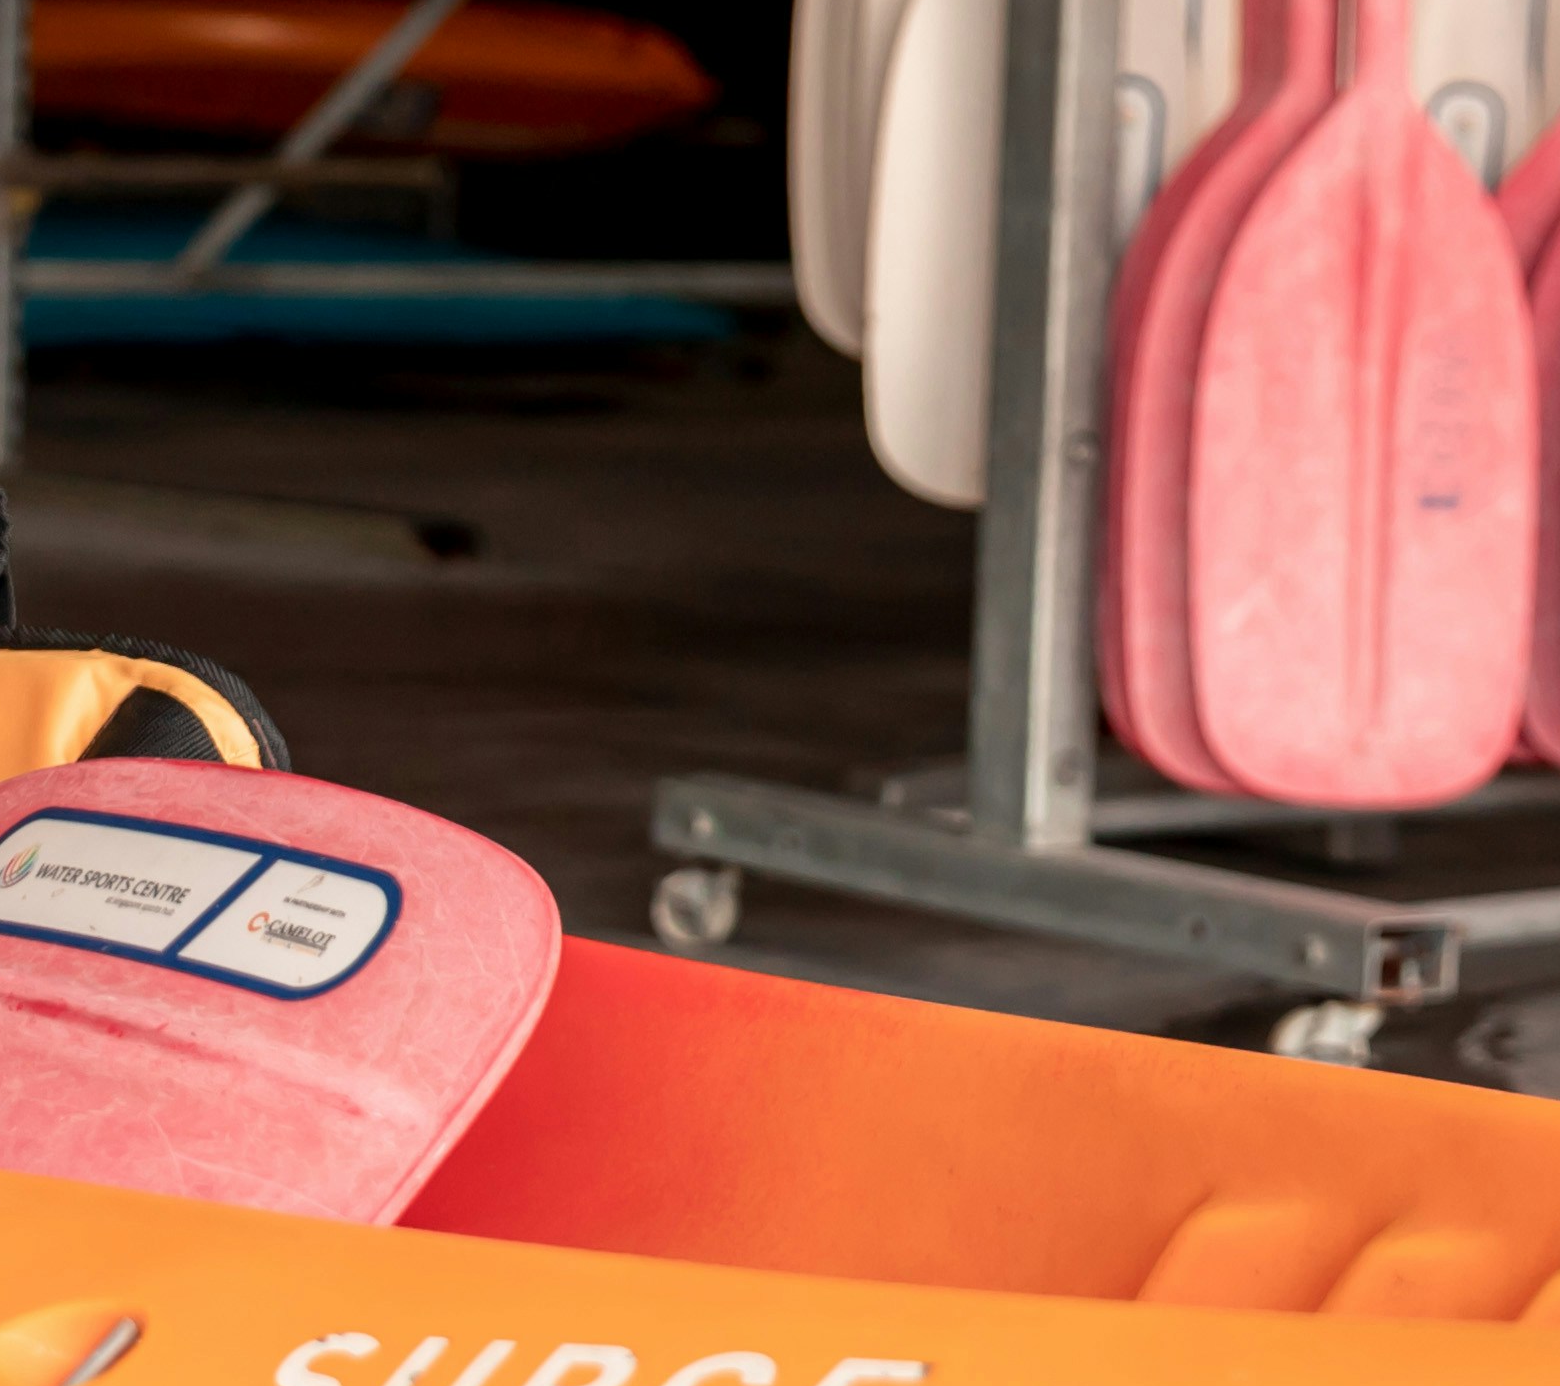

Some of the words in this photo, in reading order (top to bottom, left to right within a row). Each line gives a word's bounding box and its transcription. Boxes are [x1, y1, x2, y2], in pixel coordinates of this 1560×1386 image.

[36, 863, 81, 883] WATER
[79, 870, 134, 893] SPORTS
[132, 880, 191, 903] CENTRE
[268, 919, 336, 949] CAMELOT
